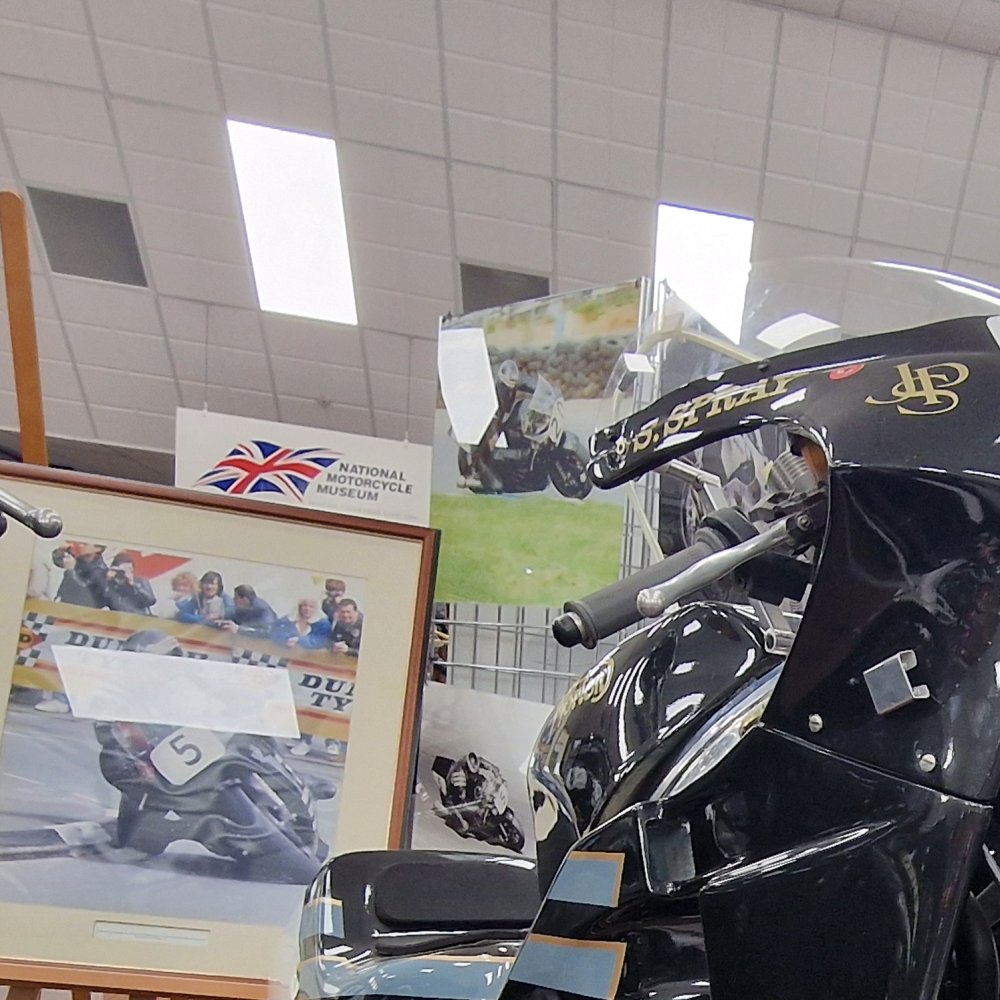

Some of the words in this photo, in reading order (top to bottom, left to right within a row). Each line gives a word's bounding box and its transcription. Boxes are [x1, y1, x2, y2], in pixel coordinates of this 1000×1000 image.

[339, 462, 407, 482] NATIONAL
[316, 484, 379, 501] MUSEUM
[326, 473, 414, 494] MOTORCYCLE
[168, 734, 202, 766] 5
